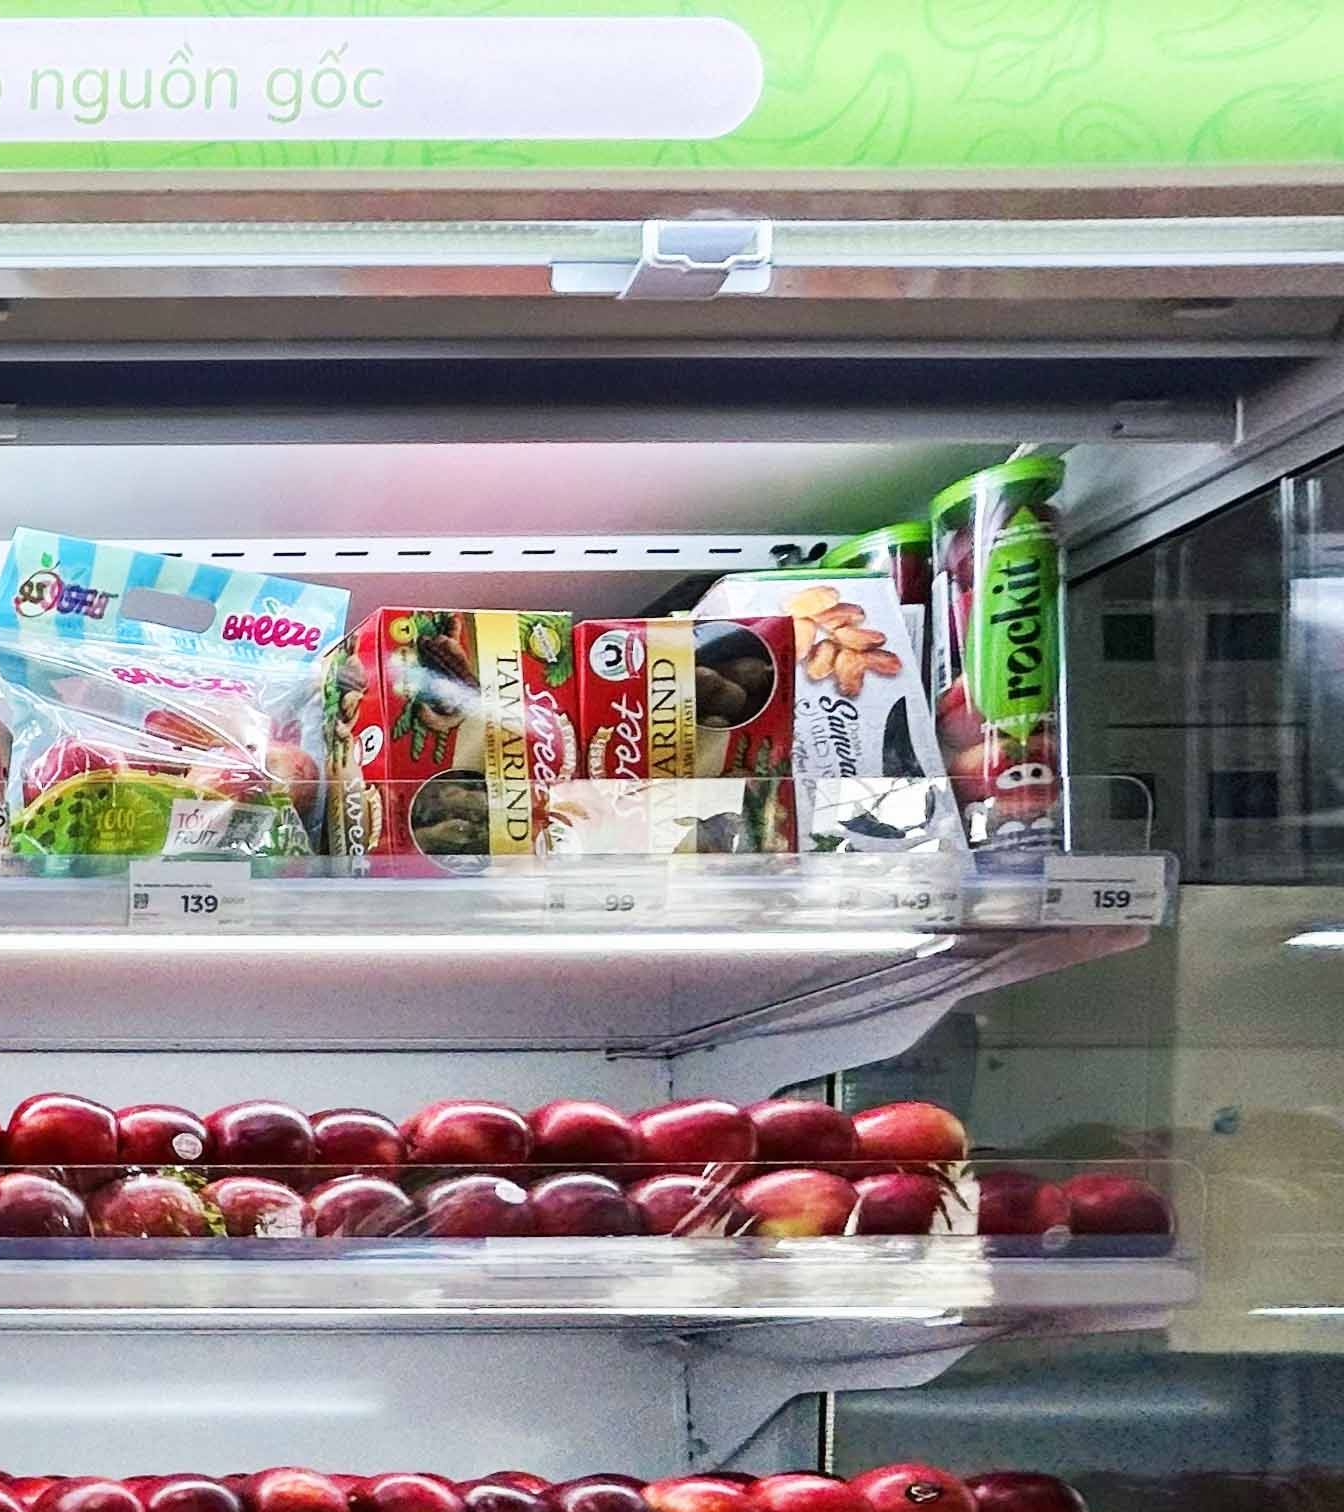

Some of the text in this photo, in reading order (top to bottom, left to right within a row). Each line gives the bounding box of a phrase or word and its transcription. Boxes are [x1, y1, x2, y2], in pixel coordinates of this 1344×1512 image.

[29, 42, 239, 125] nguồn
[265, 41, 385, 125] gốc
[990, 557, 1044, 700] rockit
[496, 655, 530, 842] TAMARIND
[525, 684, 558, 800] Sweet
[180, 894, 218, 913] 139
[1093, 889, 1131, 908] 159
